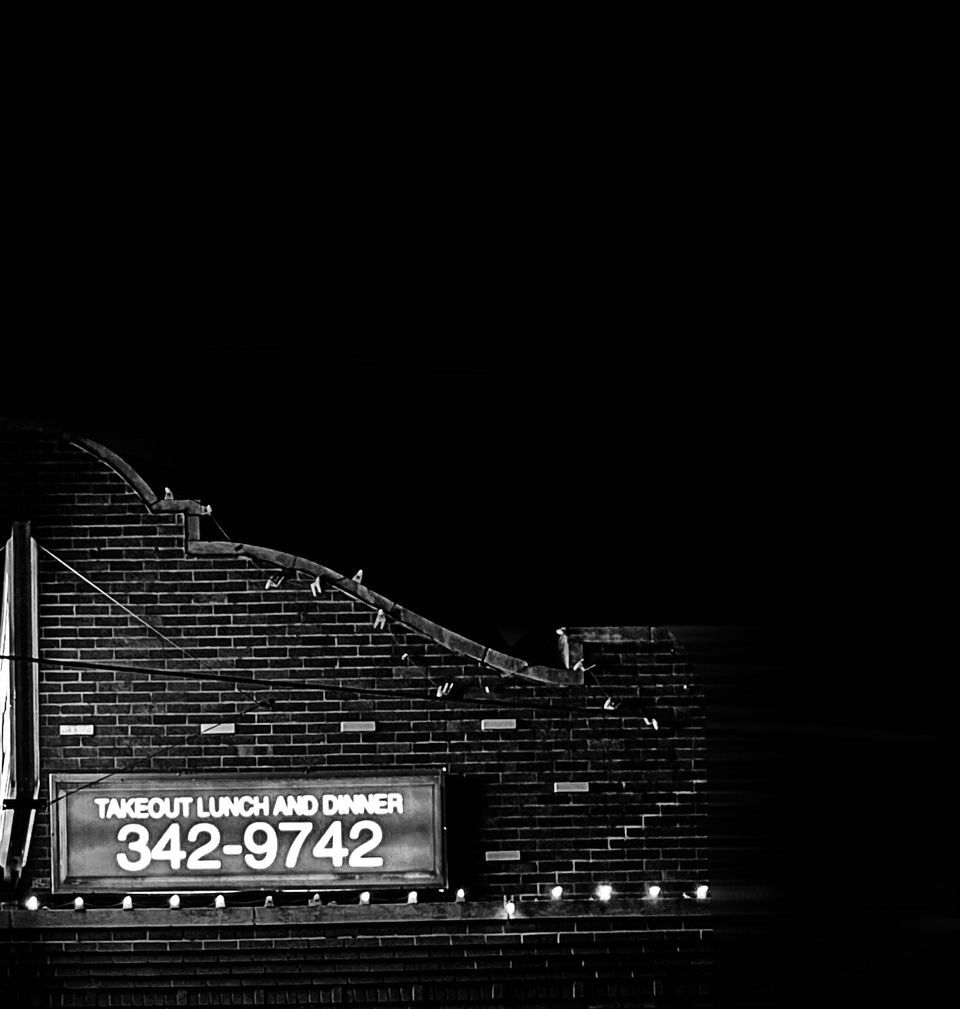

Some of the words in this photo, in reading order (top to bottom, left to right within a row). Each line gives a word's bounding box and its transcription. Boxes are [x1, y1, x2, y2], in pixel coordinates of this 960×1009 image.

[94, 797, 194, 819] TAKEOUT
[196, 795, 270, 818] LUNCH
[272, 794, 319, 816] AND
[322, 793, 404, 816] DINNER
[116, 820, 384, 872] 342-9742
